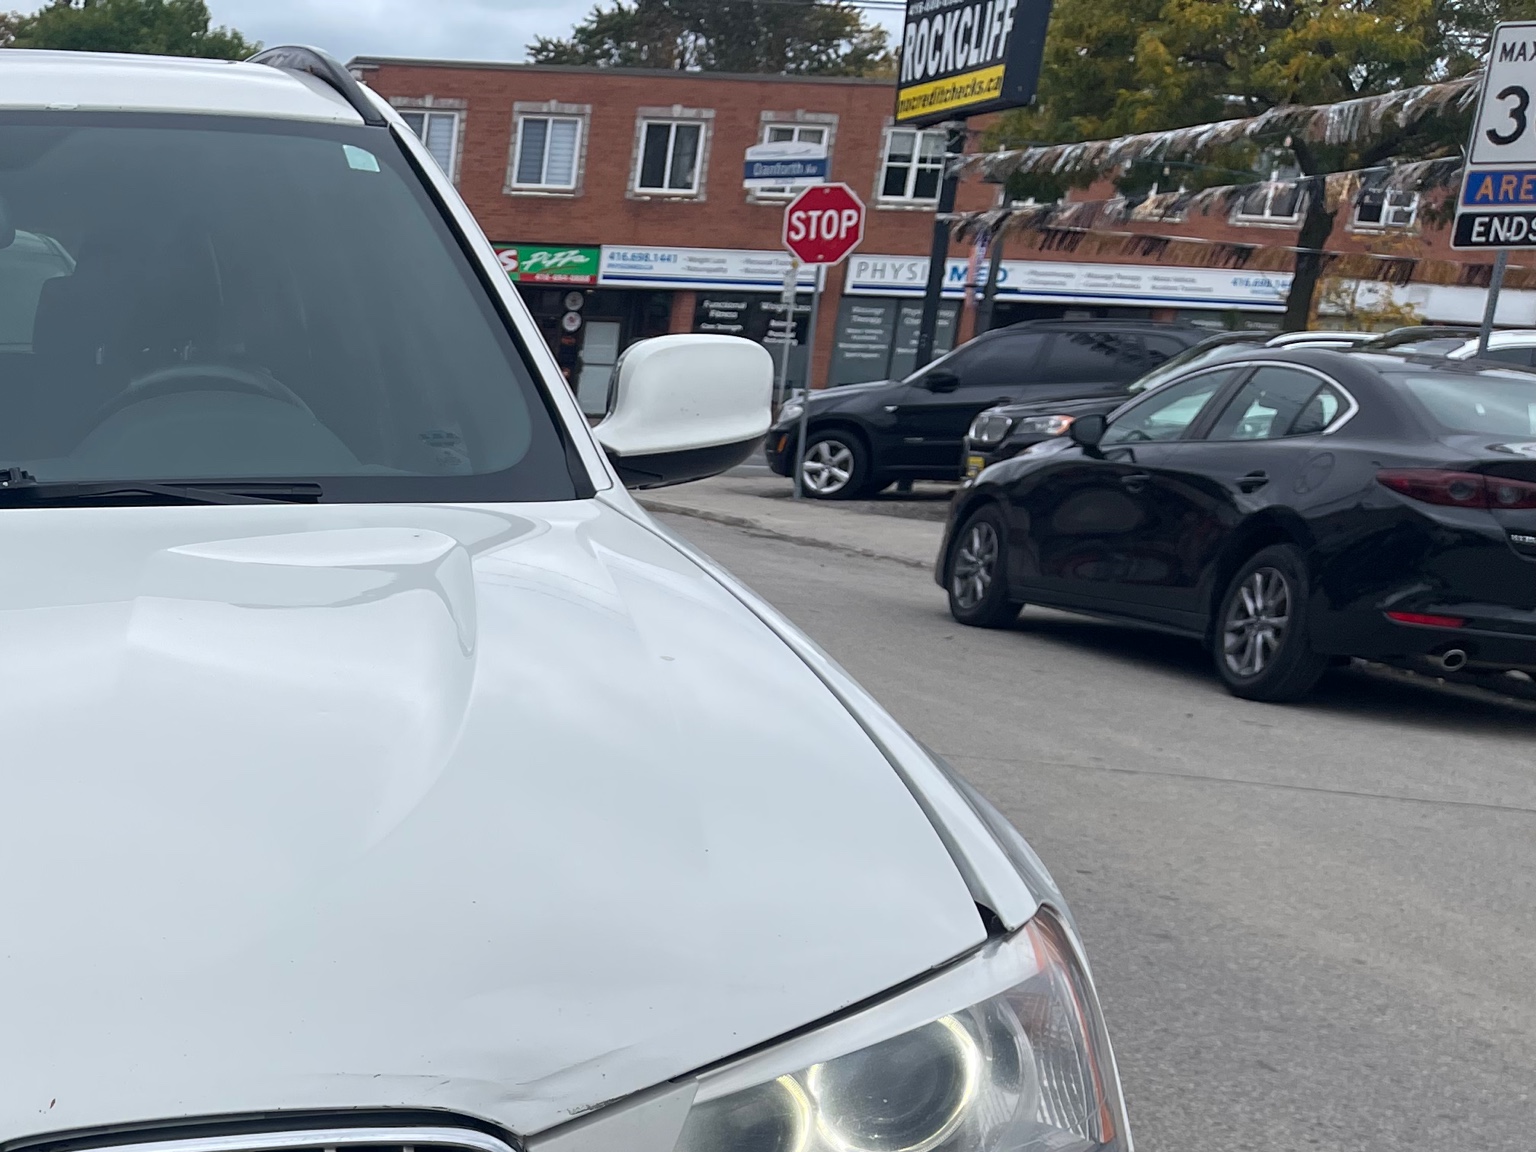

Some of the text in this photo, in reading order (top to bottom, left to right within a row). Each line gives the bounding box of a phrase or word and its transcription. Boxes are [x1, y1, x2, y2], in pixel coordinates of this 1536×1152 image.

[901, 0, 1017, 83] ROCKCLIFF
[1486, 85, 1536, 145] 3
[789, 209, 858, 241] STOP
